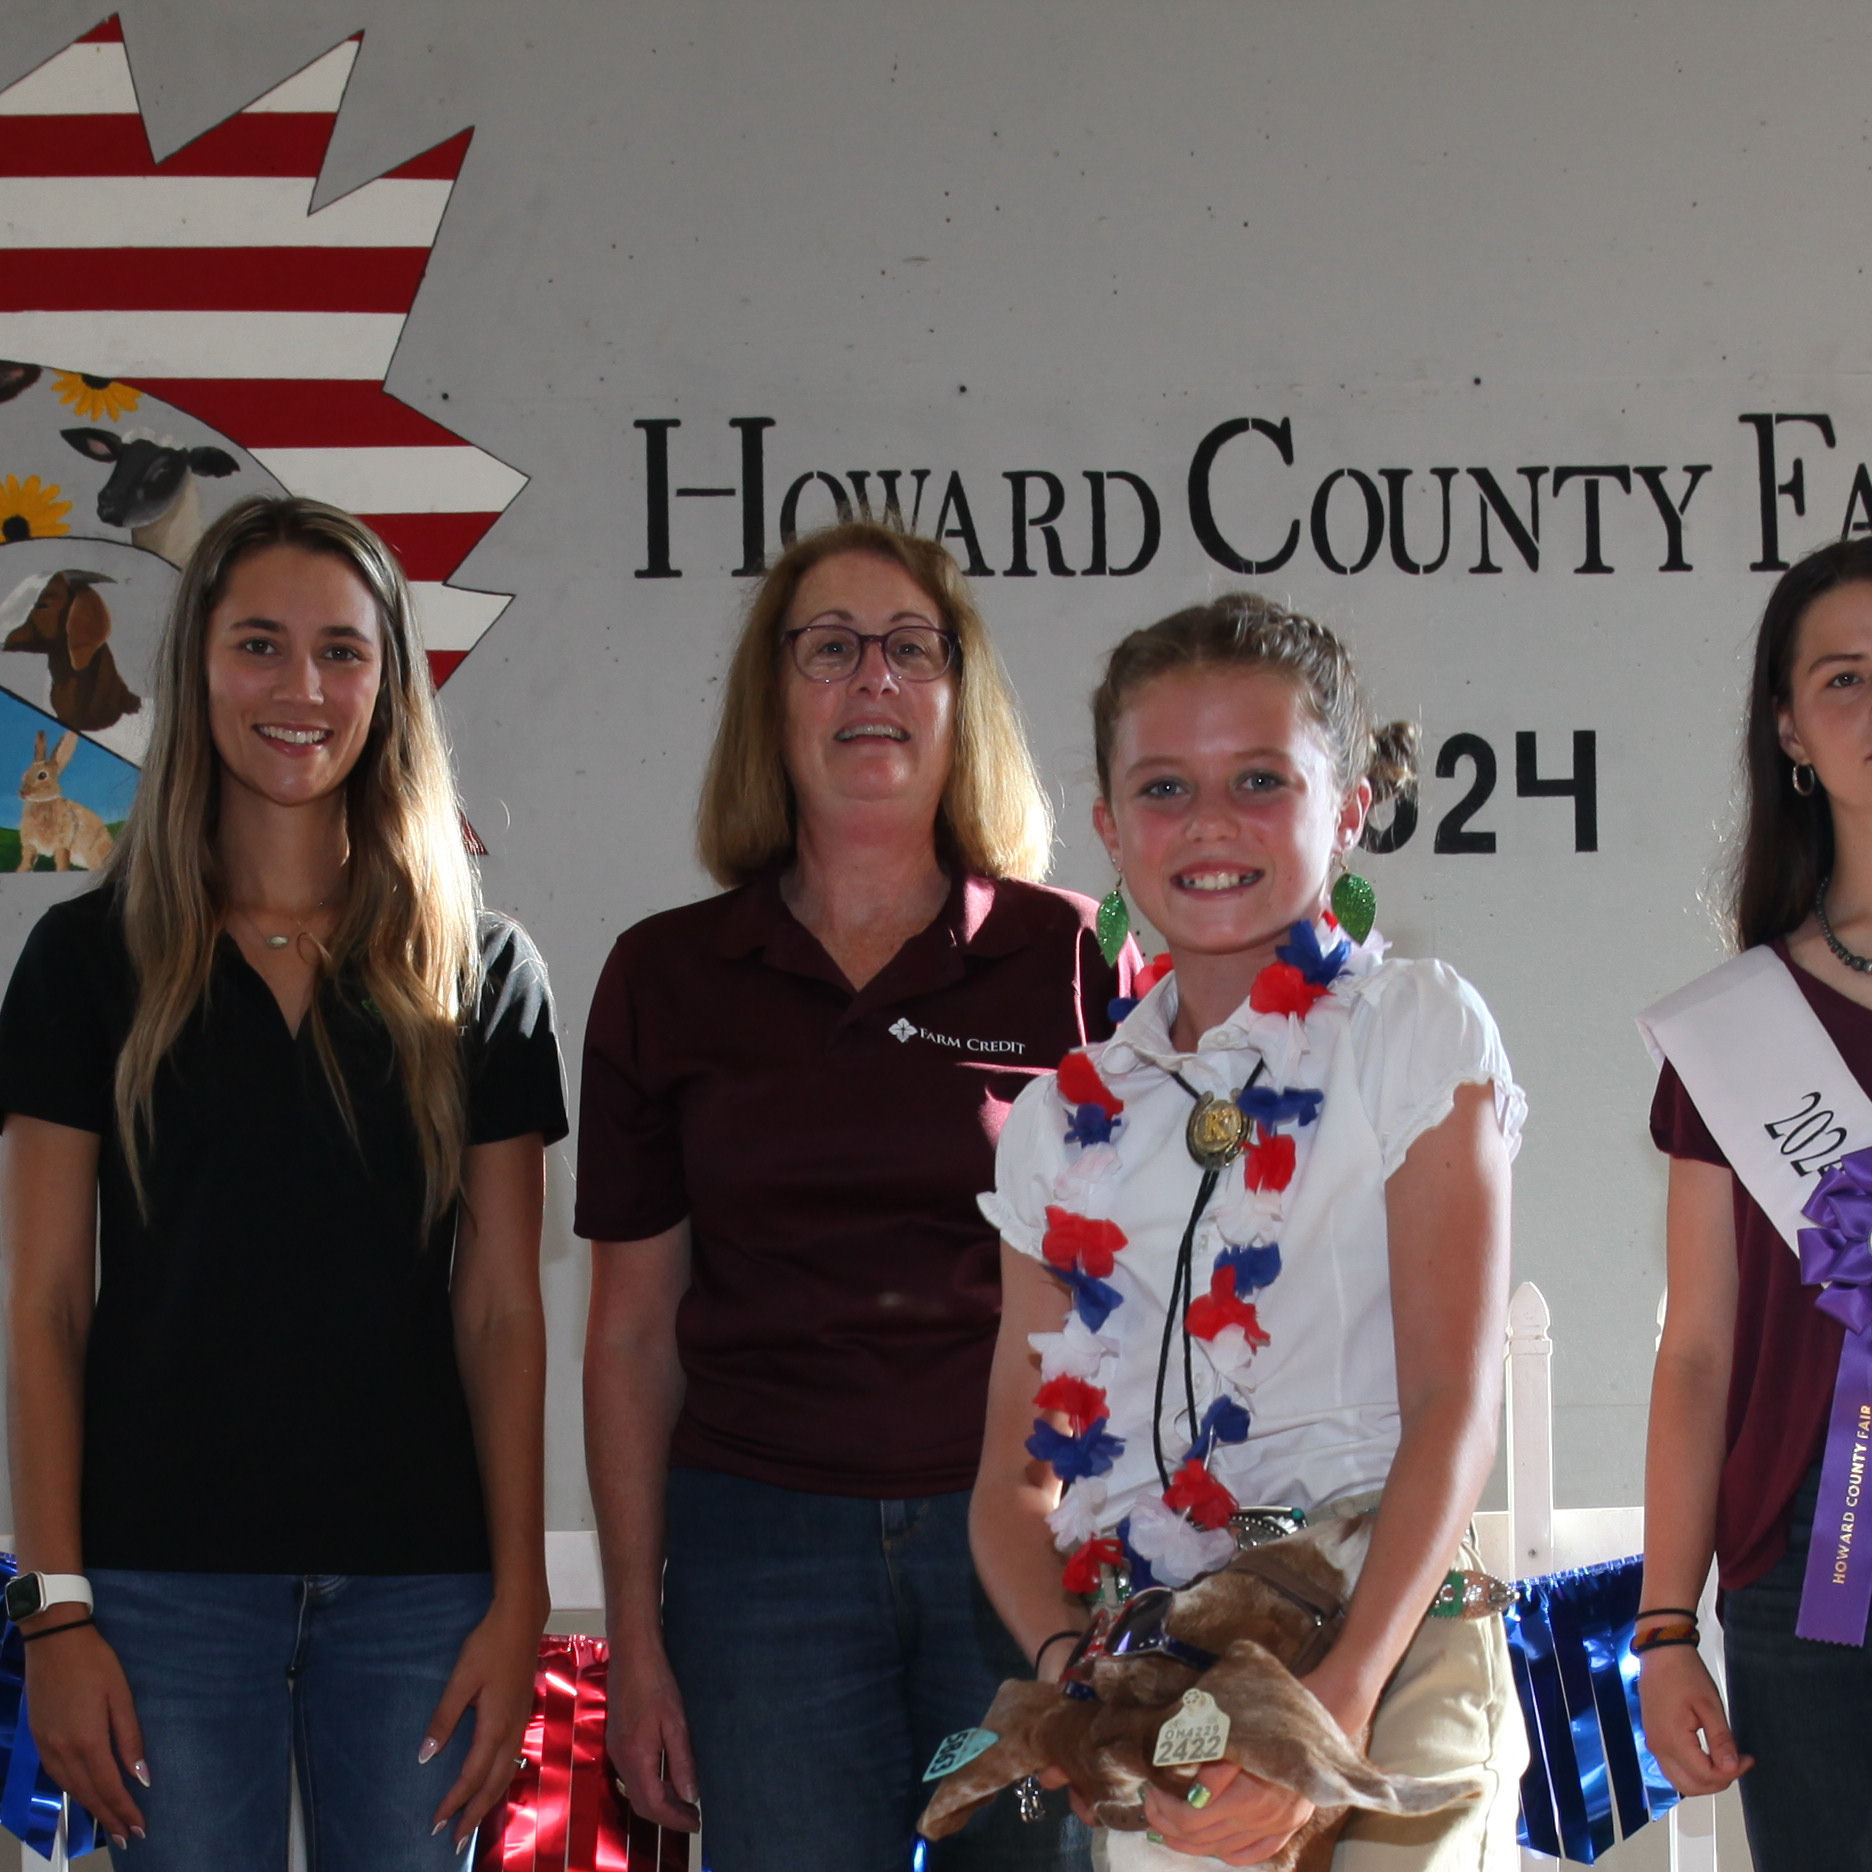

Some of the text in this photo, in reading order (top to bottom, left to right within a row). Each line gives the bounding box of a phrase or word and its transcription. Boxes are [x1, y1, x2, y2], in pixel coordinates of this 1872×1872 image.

[633, 417, 1160, 578] HOWARD
[1186, 416, 1711, 575] COUNTY
[1357, 730, 1598, 854] 024
[919, 1027, 1026, 1055] FARM CREDIT
[1764, 1091, 1847, 1178] 202
[1832, 1404, 1872, 1585] HOWARD COUNTY FAIR
[1156, 1735, 1222, 1764] 2422
